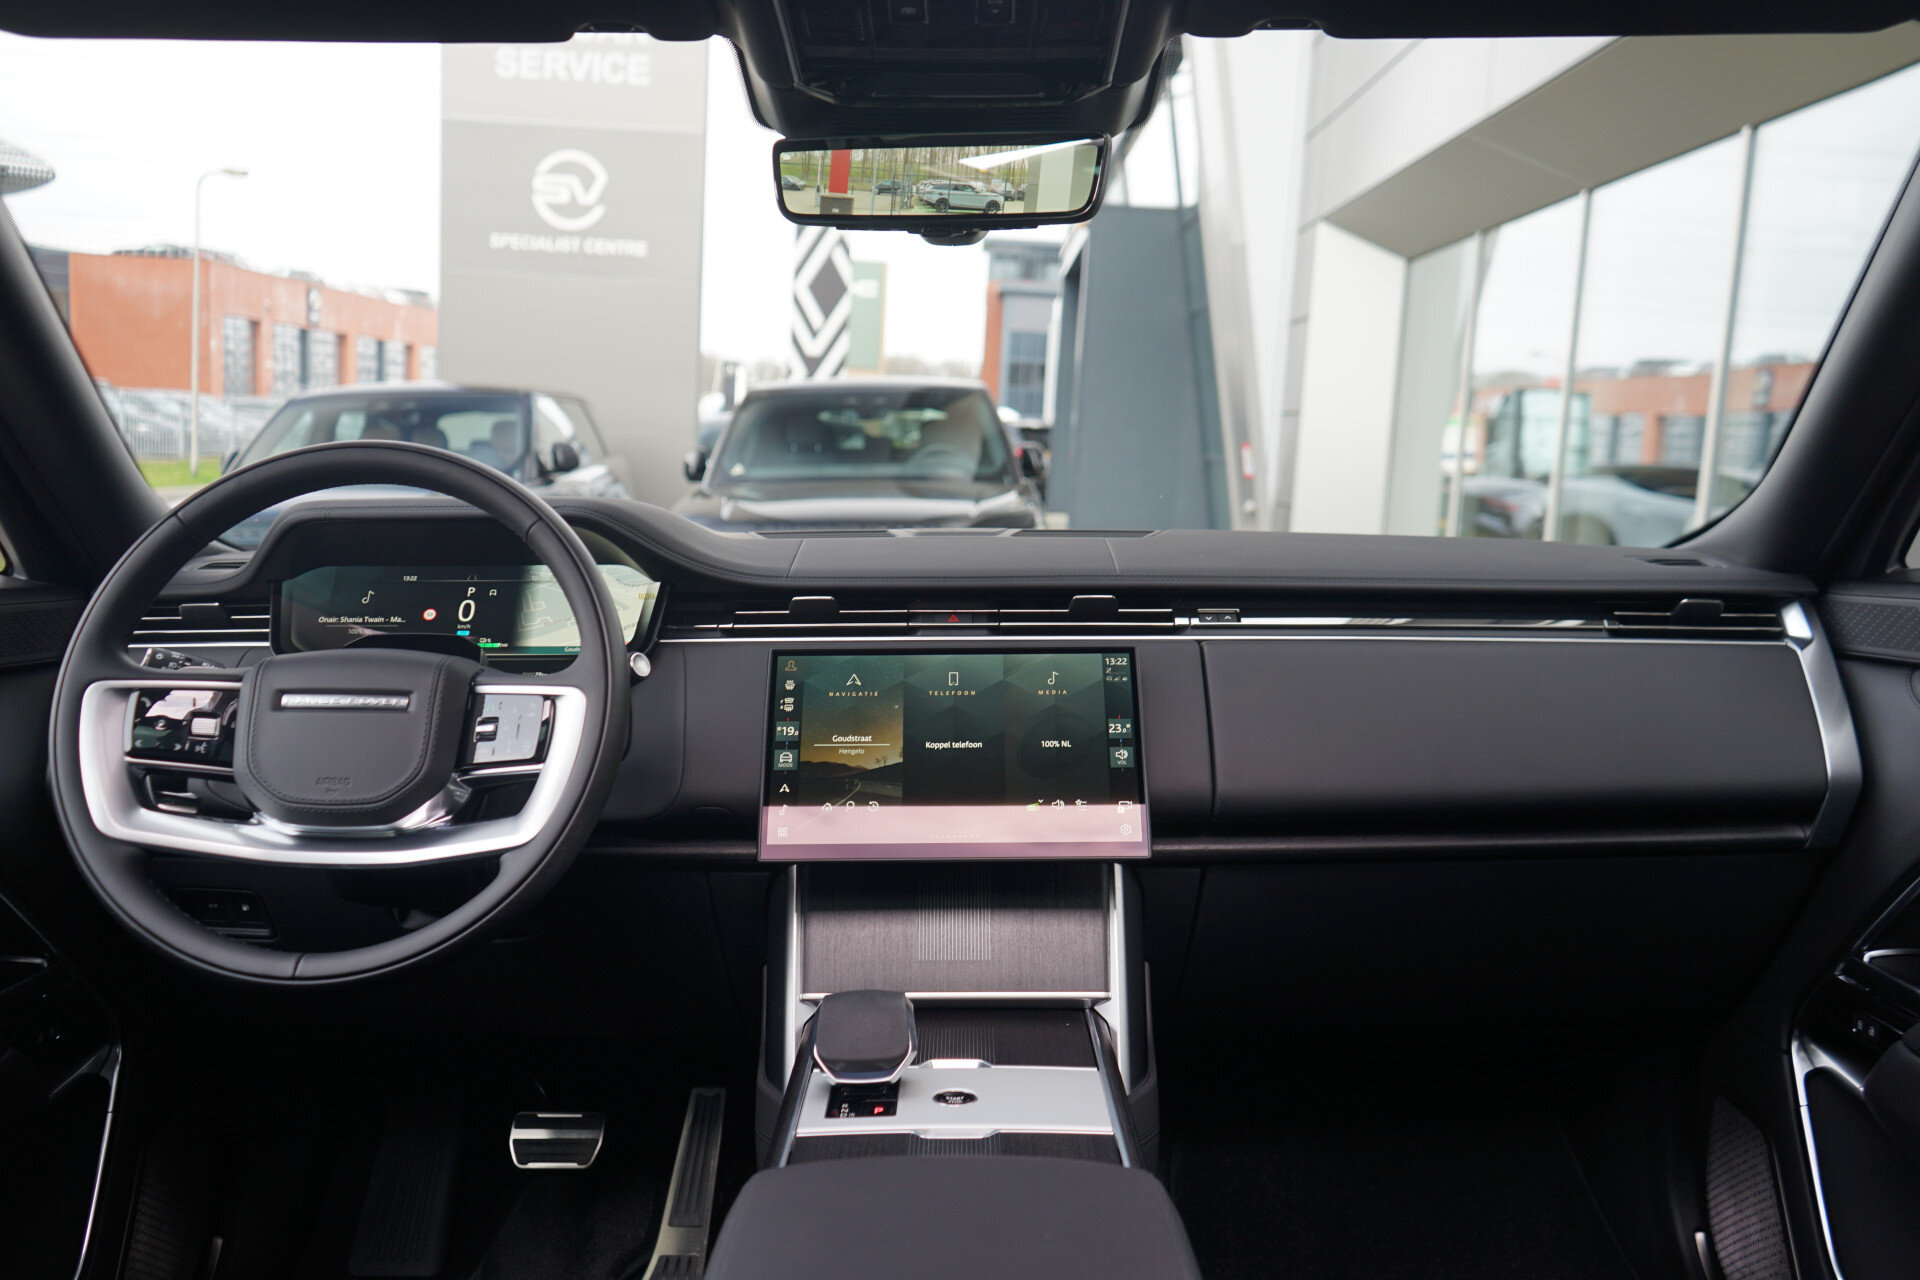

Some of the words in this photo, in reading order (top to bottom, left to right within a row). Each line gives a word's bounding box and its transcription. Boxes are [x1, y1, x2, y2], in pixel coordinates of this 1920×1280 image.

[494, 46, 651, 86] SERVICE
[488, 231, 582, 254] SPECIALIST
[582, 236, 649, 259] CENTRE
[467, 586, 476, 597] P
[457, 599, 476, 623] 0
[1105, 657, 1128, 666] 13:22
[925, 741, 950, 749] Koppel
[1041, 740, 1060, 748] 100%
[1061, 740, 1072, 748] NL
[839, 748, 865, 756] Hengelo
[873, 1105, 884, 1115] P
